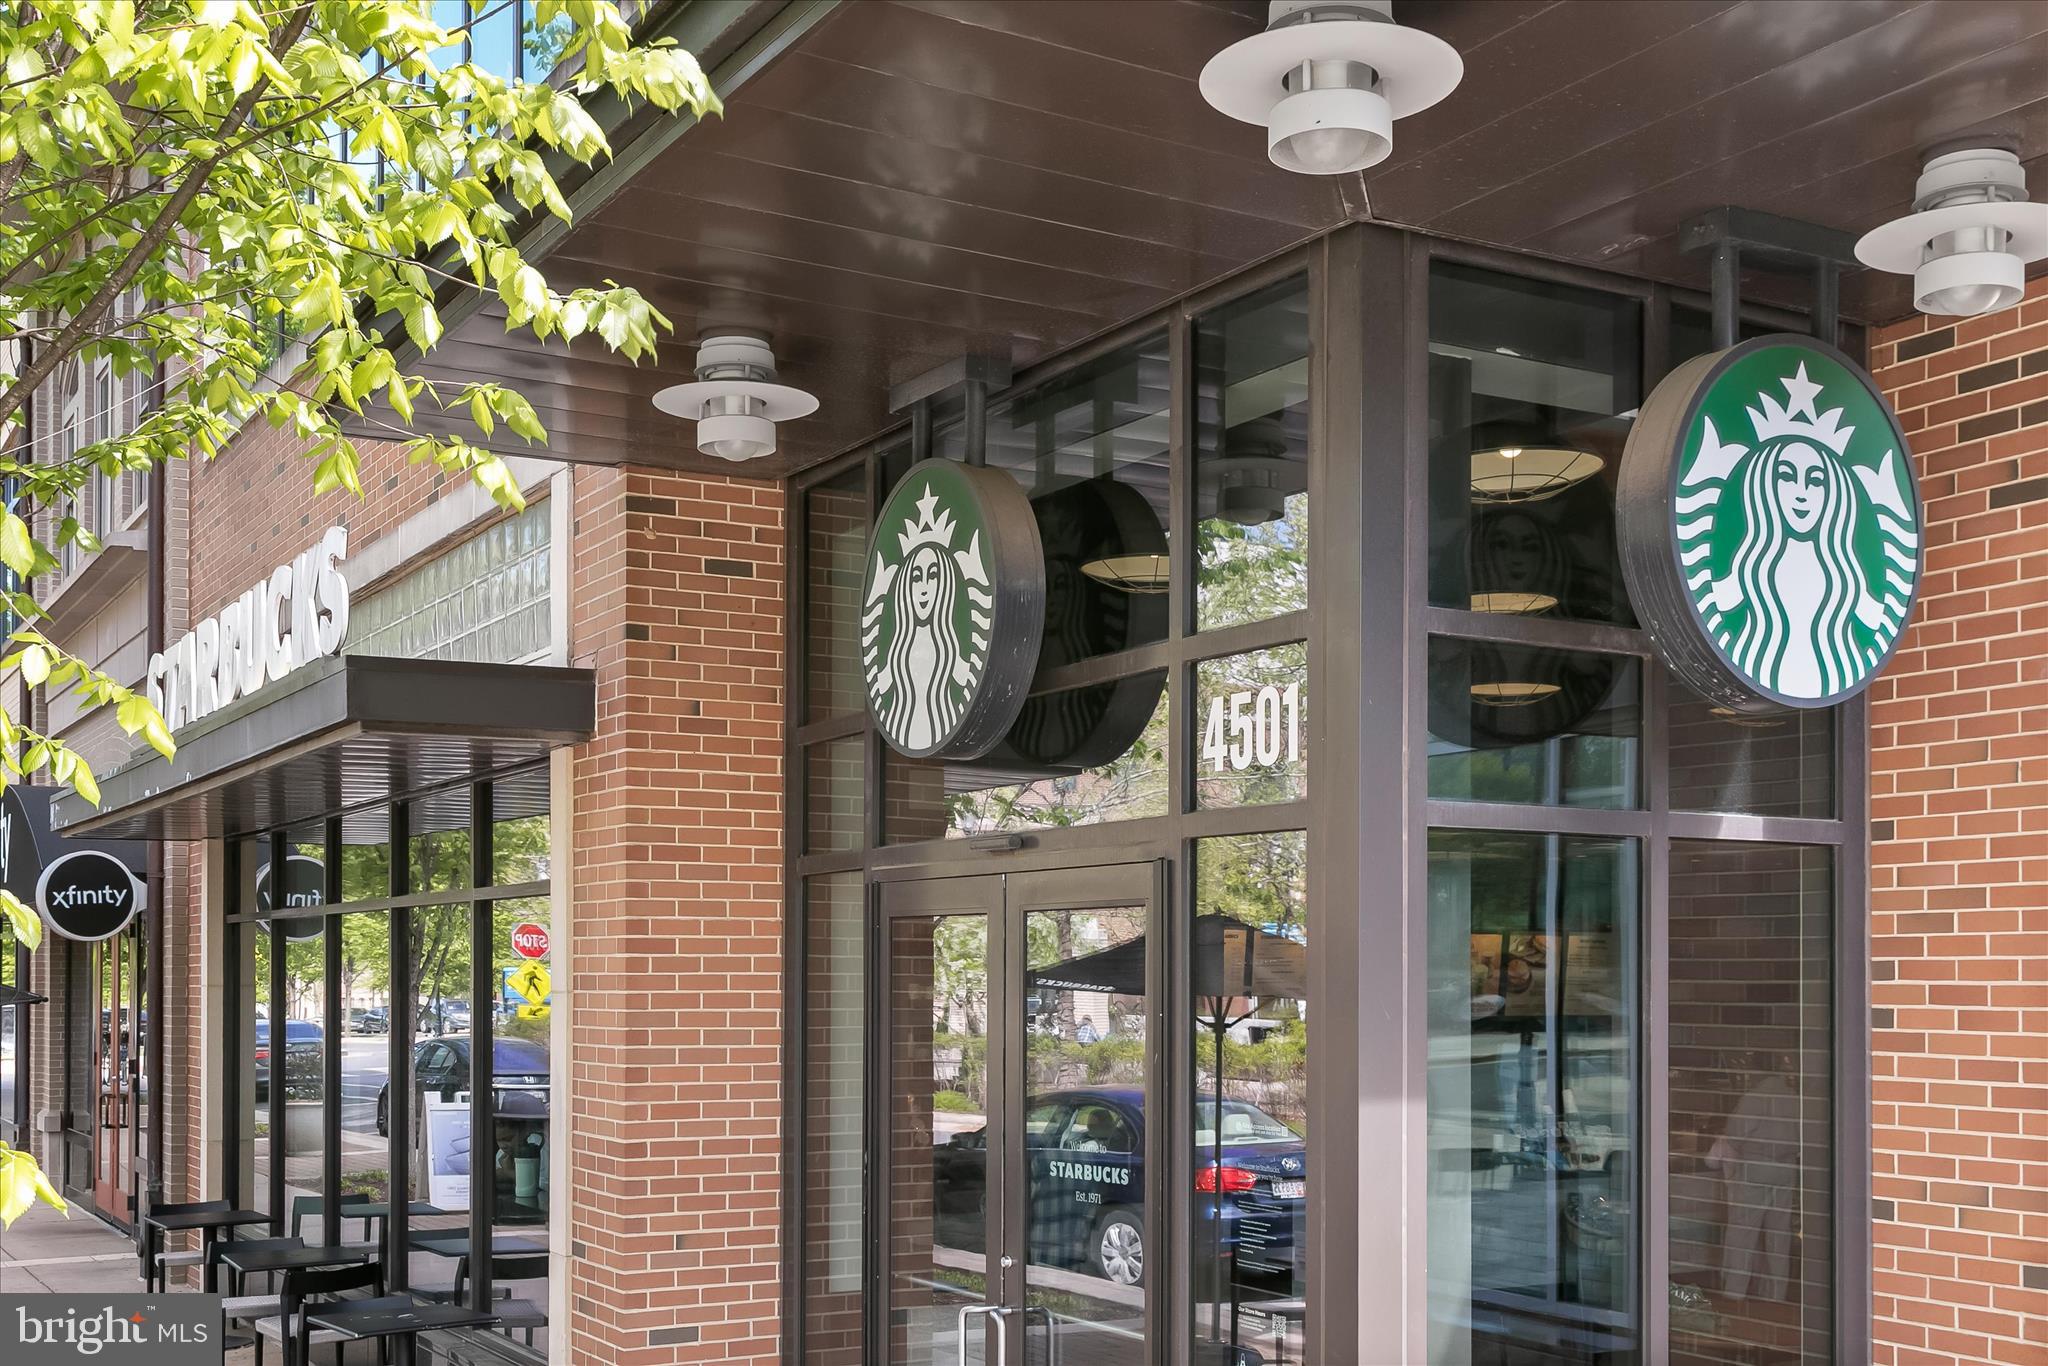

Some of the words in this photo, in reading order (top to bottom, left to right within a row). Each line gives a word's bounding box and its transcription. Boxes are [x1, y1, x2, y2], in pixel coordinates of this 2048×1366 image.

[147, 526, 350, 733] STARBUCKS
[1203, 681, 1299, 772] 4501
[52, 884, 128, 909] xfinity
[1070, 1141, 1099, 1154] Welcome
[1100, 1144, 1107, 1154] to
[1049, 1160, 1130, 1186] STARBUCKS
[1075, 1190, 1088, 1202] Est.
[1088, 1192, 1102, 1204] 1971
